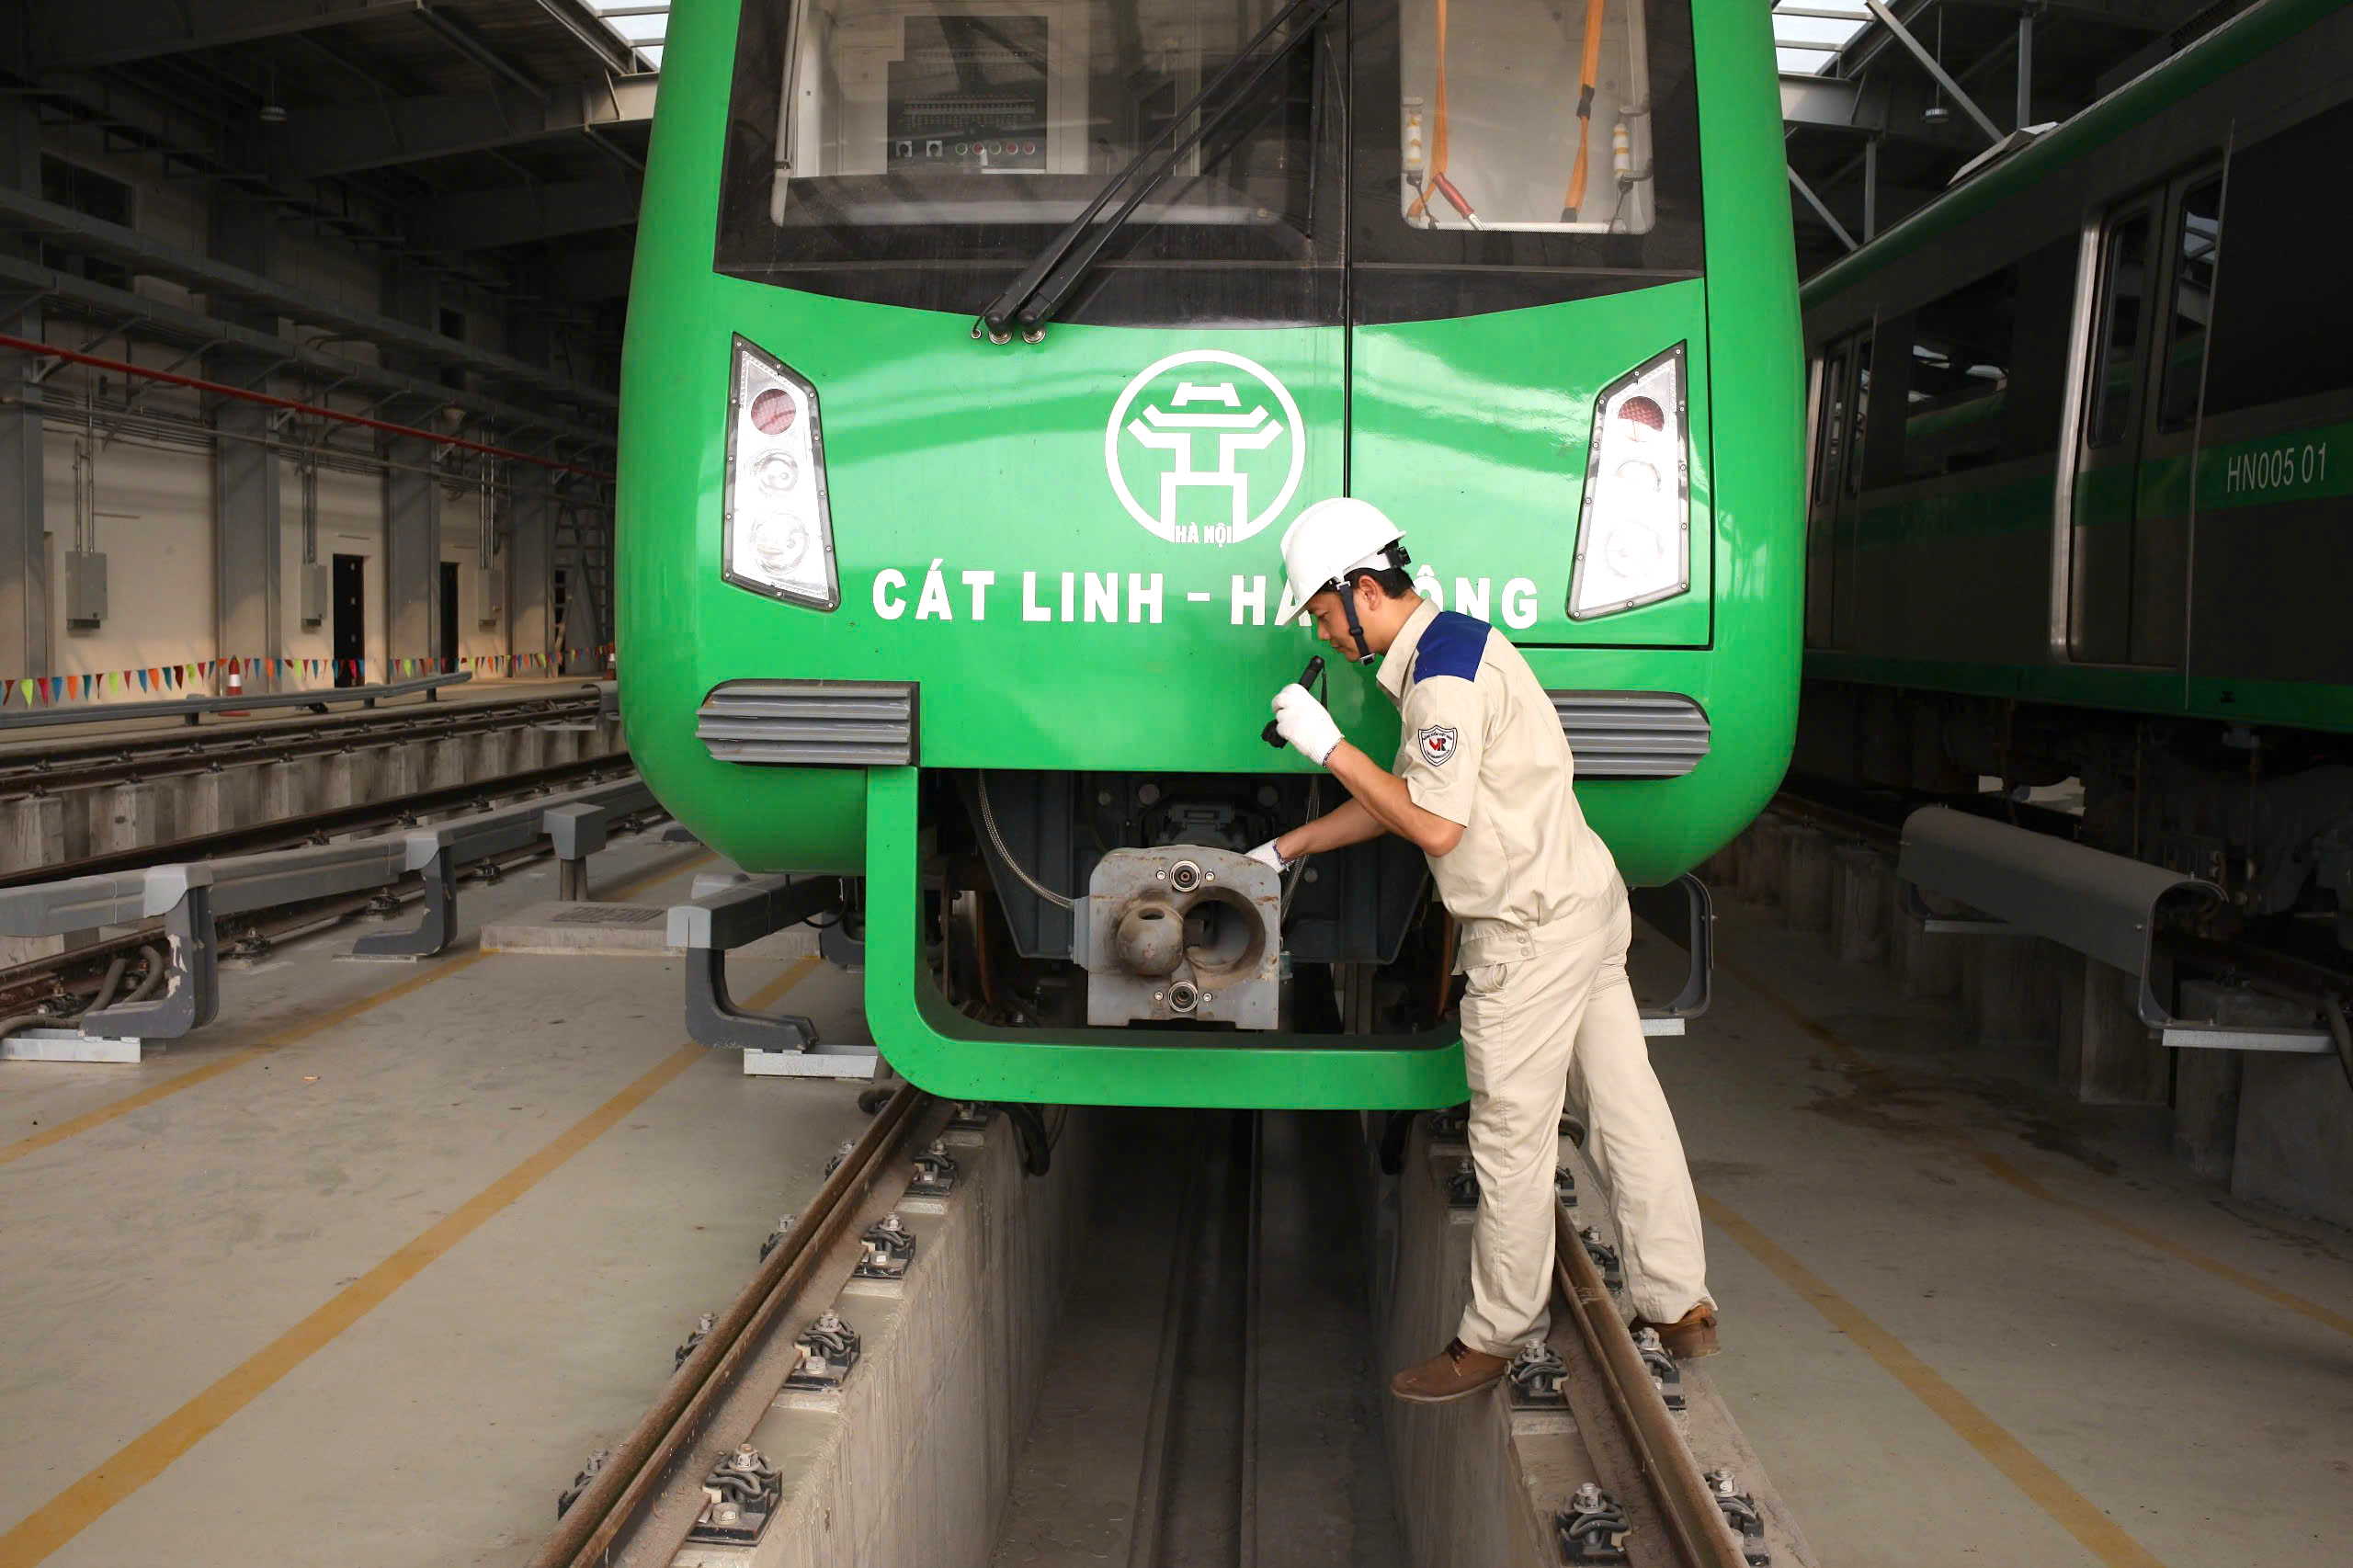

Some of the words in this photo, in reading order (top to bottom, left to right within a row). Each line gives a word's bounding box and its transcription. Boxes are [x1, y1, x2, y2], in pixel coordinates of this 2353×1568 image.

[2226, 447, 2295, 493] HN005
[2302, 442, 2326, 484] 01
[1176, 522, 1199, 543] HÀ
[1203, 522, 1232, 547] NỘI
[872, 558, 995, 620] CÁT
[1022, 571, 1164, 624] LINH
[1412, 564, 1538, 630] ÔNG
